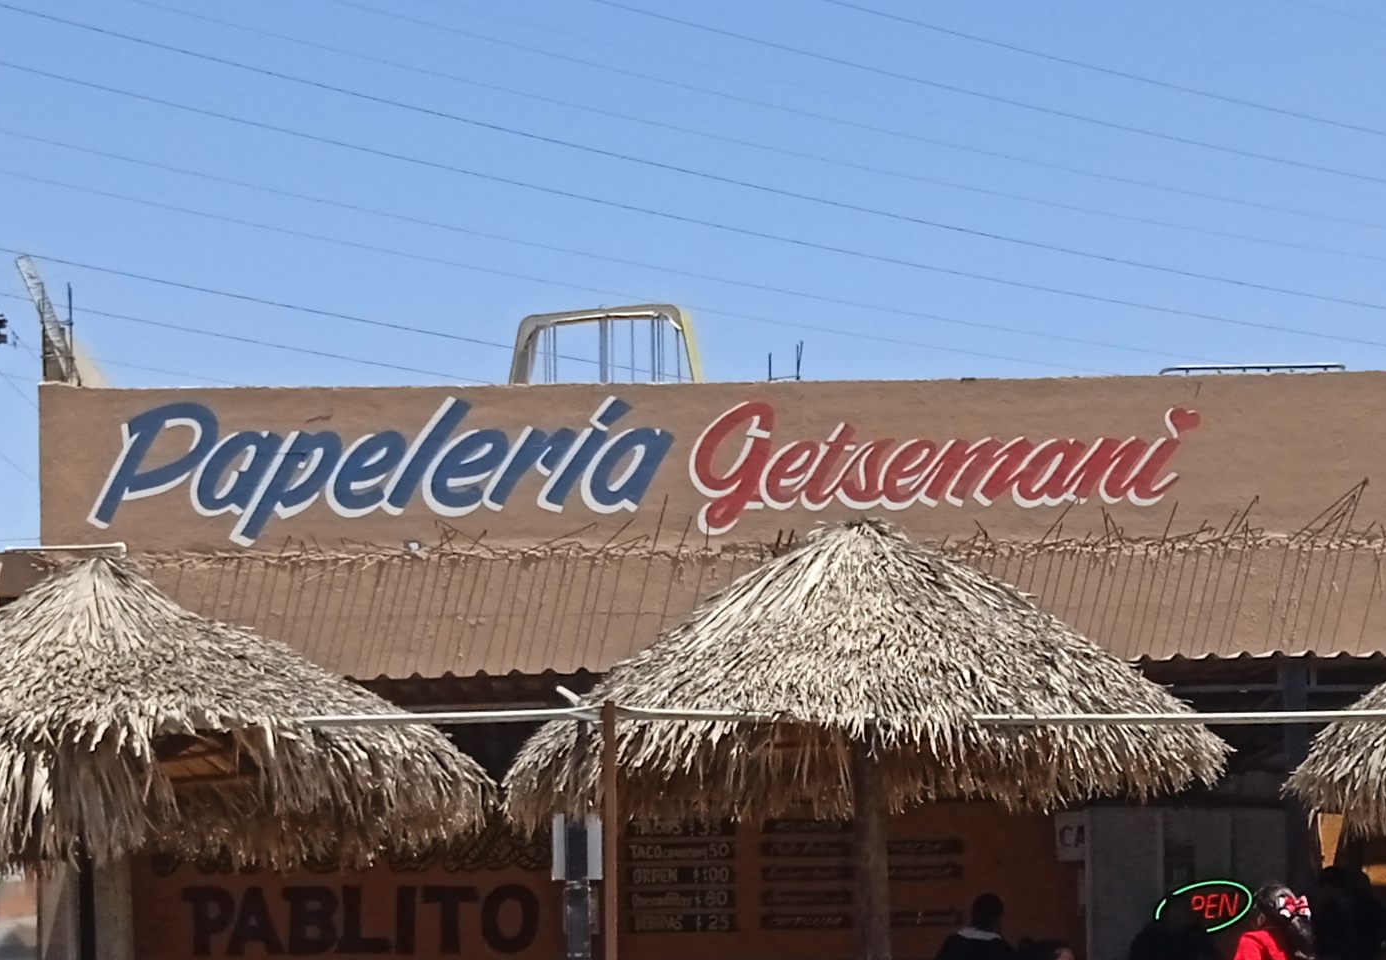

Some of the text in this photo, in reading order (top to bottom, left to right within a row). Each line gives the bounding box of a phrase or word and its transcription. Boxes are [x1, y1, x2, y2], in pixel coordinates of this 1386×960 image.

[690, 398, 1202, 537] Getsemani
[183, 883, 541, 957] PABLITO
[1191, 892, 1240, 919] PEN
